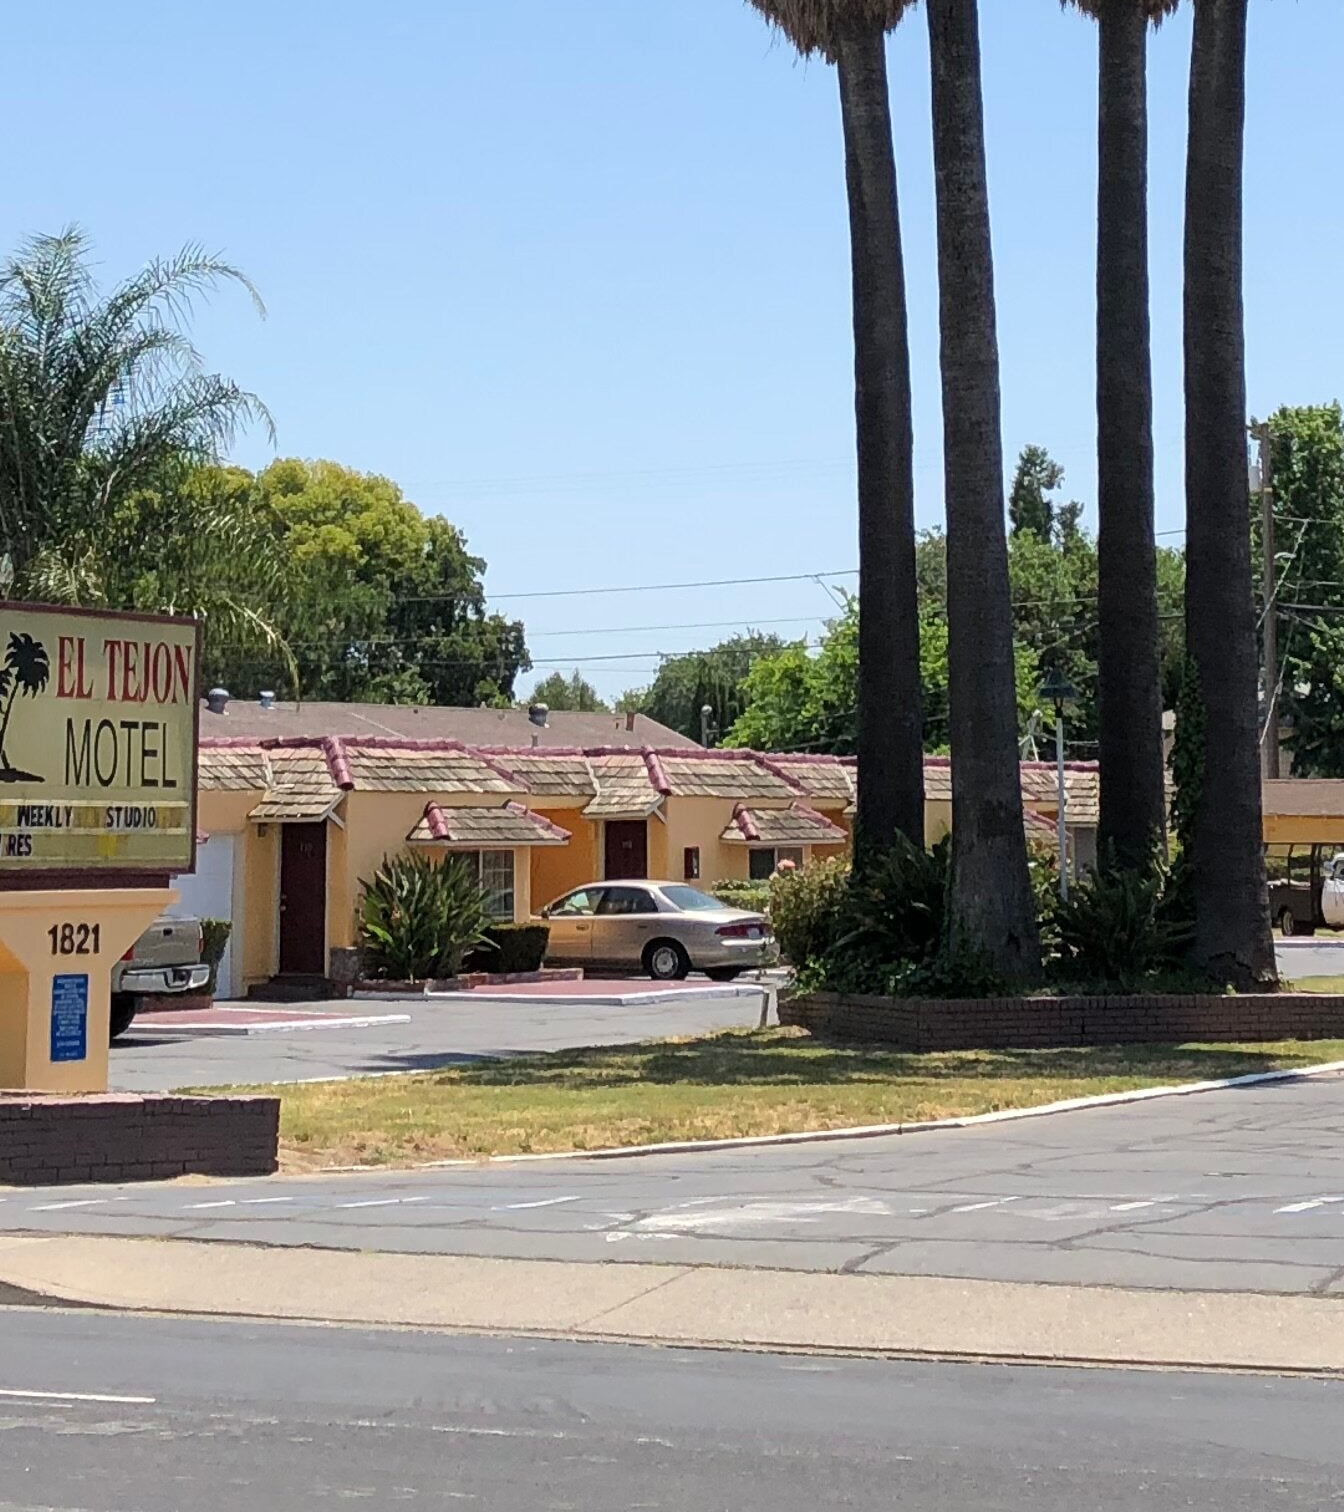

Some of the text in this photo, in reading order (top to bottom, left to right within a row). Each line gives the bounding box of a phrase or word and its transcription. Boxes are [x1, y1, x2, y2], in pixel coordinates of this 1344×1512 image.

[56, 636, 192, 705] EL TEJON
[65, 717, 177, 788] MOTEL
[17, 804, 73, 828] WEEKLY
[106, 805, 156, 829] STUDIO
[7, 834, 33, 857] RES
[47, 922, 100, 955] 1821
